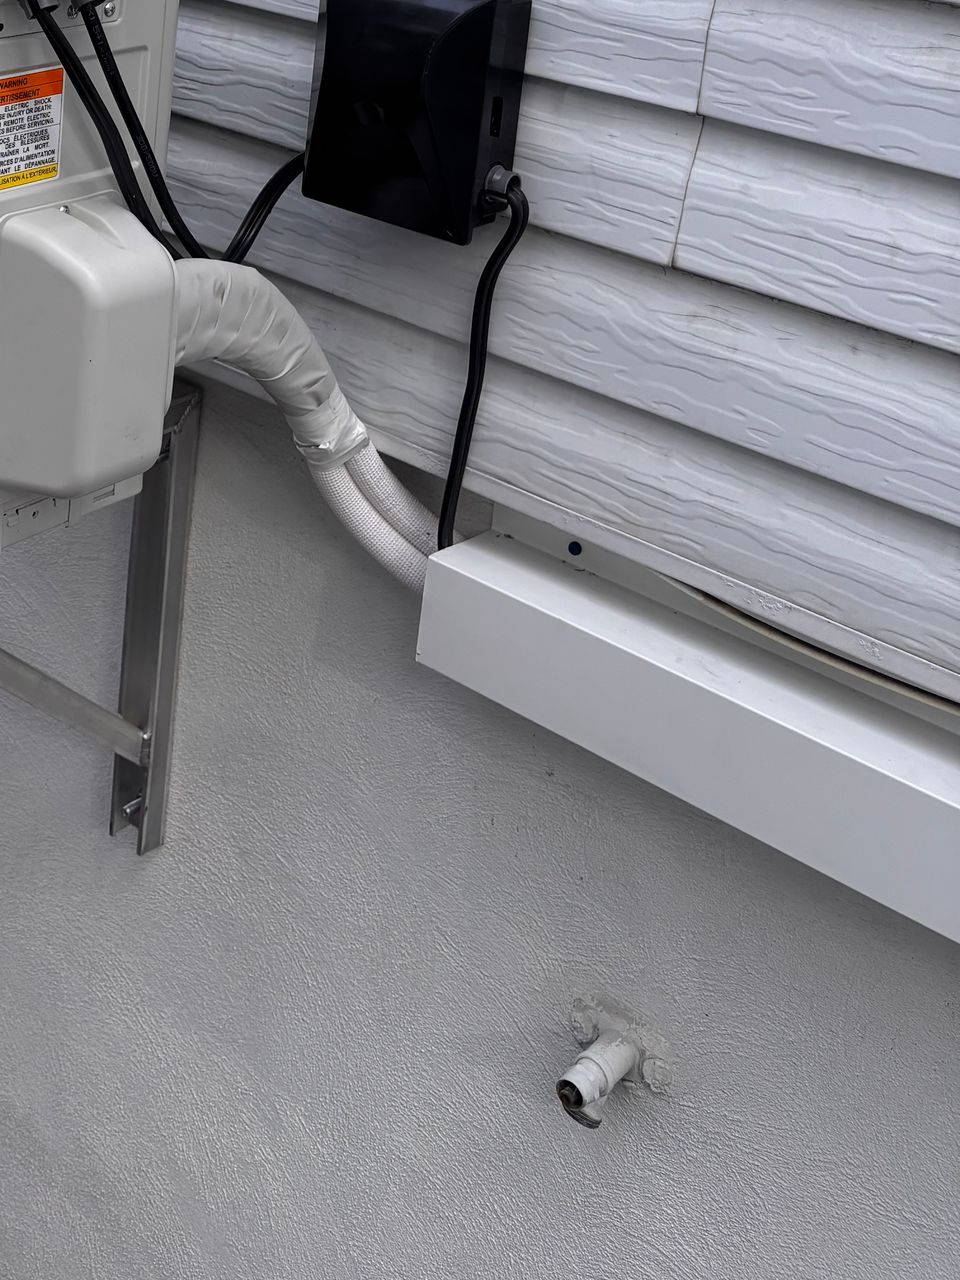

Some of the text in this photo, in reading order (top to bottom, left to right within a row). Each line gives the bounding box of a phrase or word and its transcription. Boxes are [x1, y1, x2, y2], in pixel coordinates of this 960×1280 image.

[4, 101, 28, 111] ELECTRIC
[34, 97, 52, 106] SHOCK
[3, 117, 24, 126] REMOTE
[27, 111, 50, 121] ELECTRIC
[6, 109, 26, 118] INJURY
[6, 123, 25, 133] BEFORE
[21, 134, 49, 145] BLESSURES
[14, 148, 55, 163] D'ALIMENTATION
